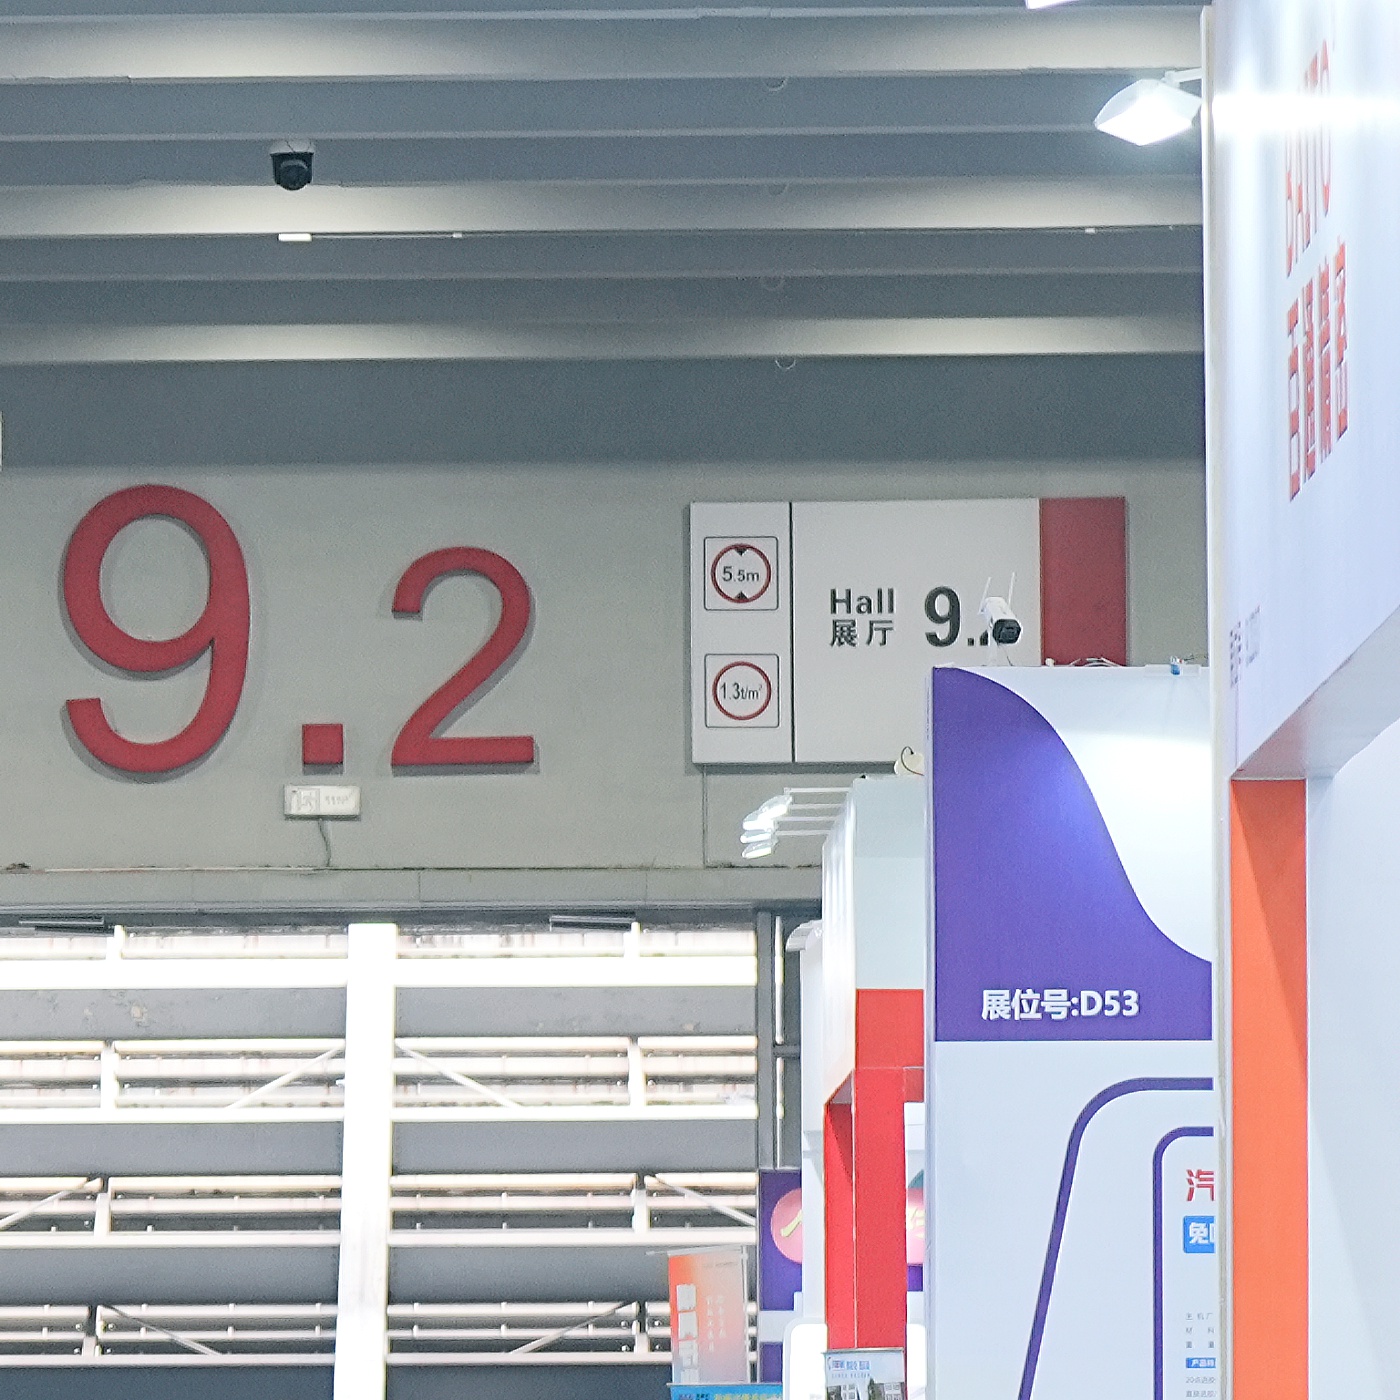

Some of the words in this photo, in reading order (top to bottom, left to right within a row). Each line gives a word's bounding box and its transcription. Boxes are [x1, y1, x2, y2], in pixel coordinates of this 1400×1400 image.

[721, 565, 761, 584] 5.5m
[829, 588, 895, 616] Hall
[924, 585, 990, 648] 9.
[62, 483, 536, 774] 9.2
[829, 619, 895, 648] 展厅
[980, 988, 1141, 1021] 展位号:D53
[1187, 1221, 1216, 1246] 免
